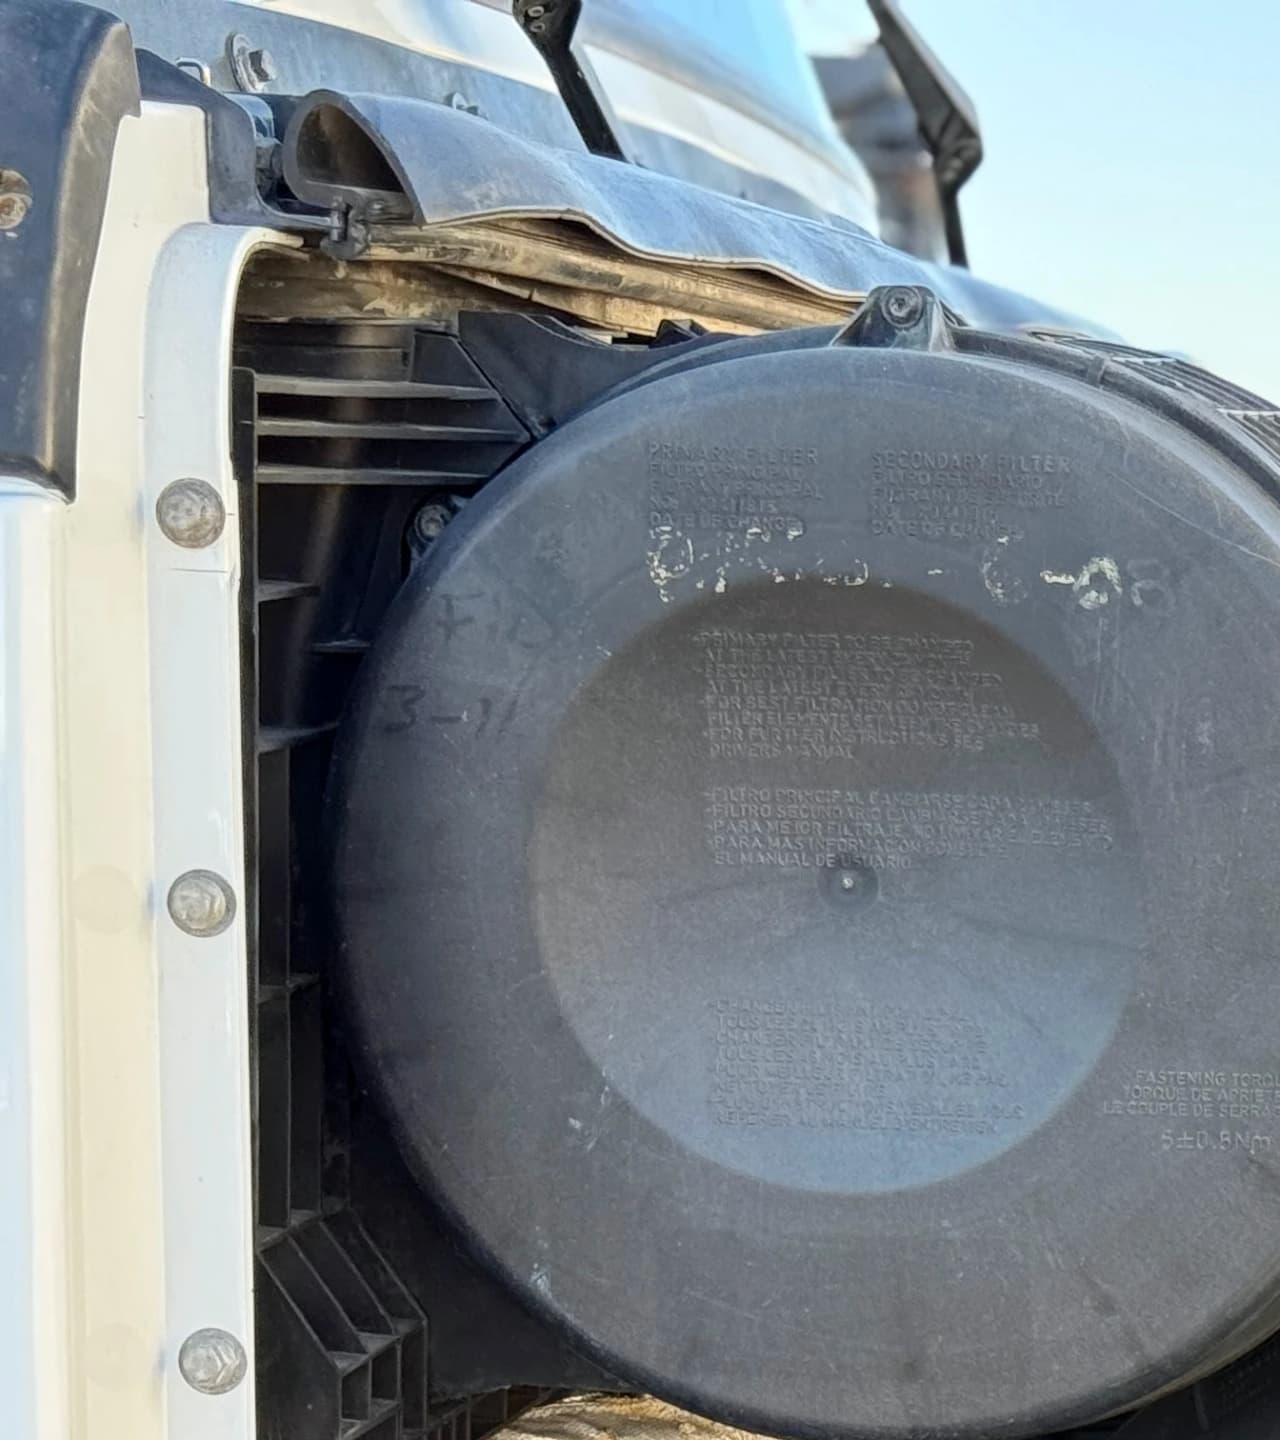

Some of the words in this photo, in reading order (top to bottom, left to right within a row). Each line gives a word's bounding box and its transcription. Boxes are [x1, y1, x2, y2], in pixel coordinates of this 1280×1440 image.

[650, 440, 736, 462] PRIMARY
[745, 446, 818, 467] FILTER
[872, 450, 989, 471] SECONDARY
[997, 454, 1072, 474] FILTER
[650, 511, 695, 527] DATE
[872, 519, 920, 537] DATE
[706, 694, 743, 711] FOR
[746, 694, 790, 711] BEST
[708, 726, 744, 742] FOR
[712, 786, 771, 803] FILTRO
[775, 788, 864, 805] PRINCIPAL
[712, 803, 772, 819] FILTRO
[776, 804, 881, 821] SECUNDARIO
[713, 819, 763, 834] PARA
[766, 820, 822, 837] MEJOR
[713, 834, 763, 850] PARA
[767, 835, 804, 851] MAS
[714, 850, 735, 866] EL
[739, 851, 810, 867] MANUAL
[815, 852, 837, 869] DE
[840, 853, 912, 870] USUARIO
[1136, 1069, 1227, 1087] FASTENING
[1191, 1085, 1213, 1102] DE
[1103, 1099, 1124, 1116] LE
[1126, 1100, 1190, 1118] COUPLE
[1192, 1102, 1214, 1119] DE
